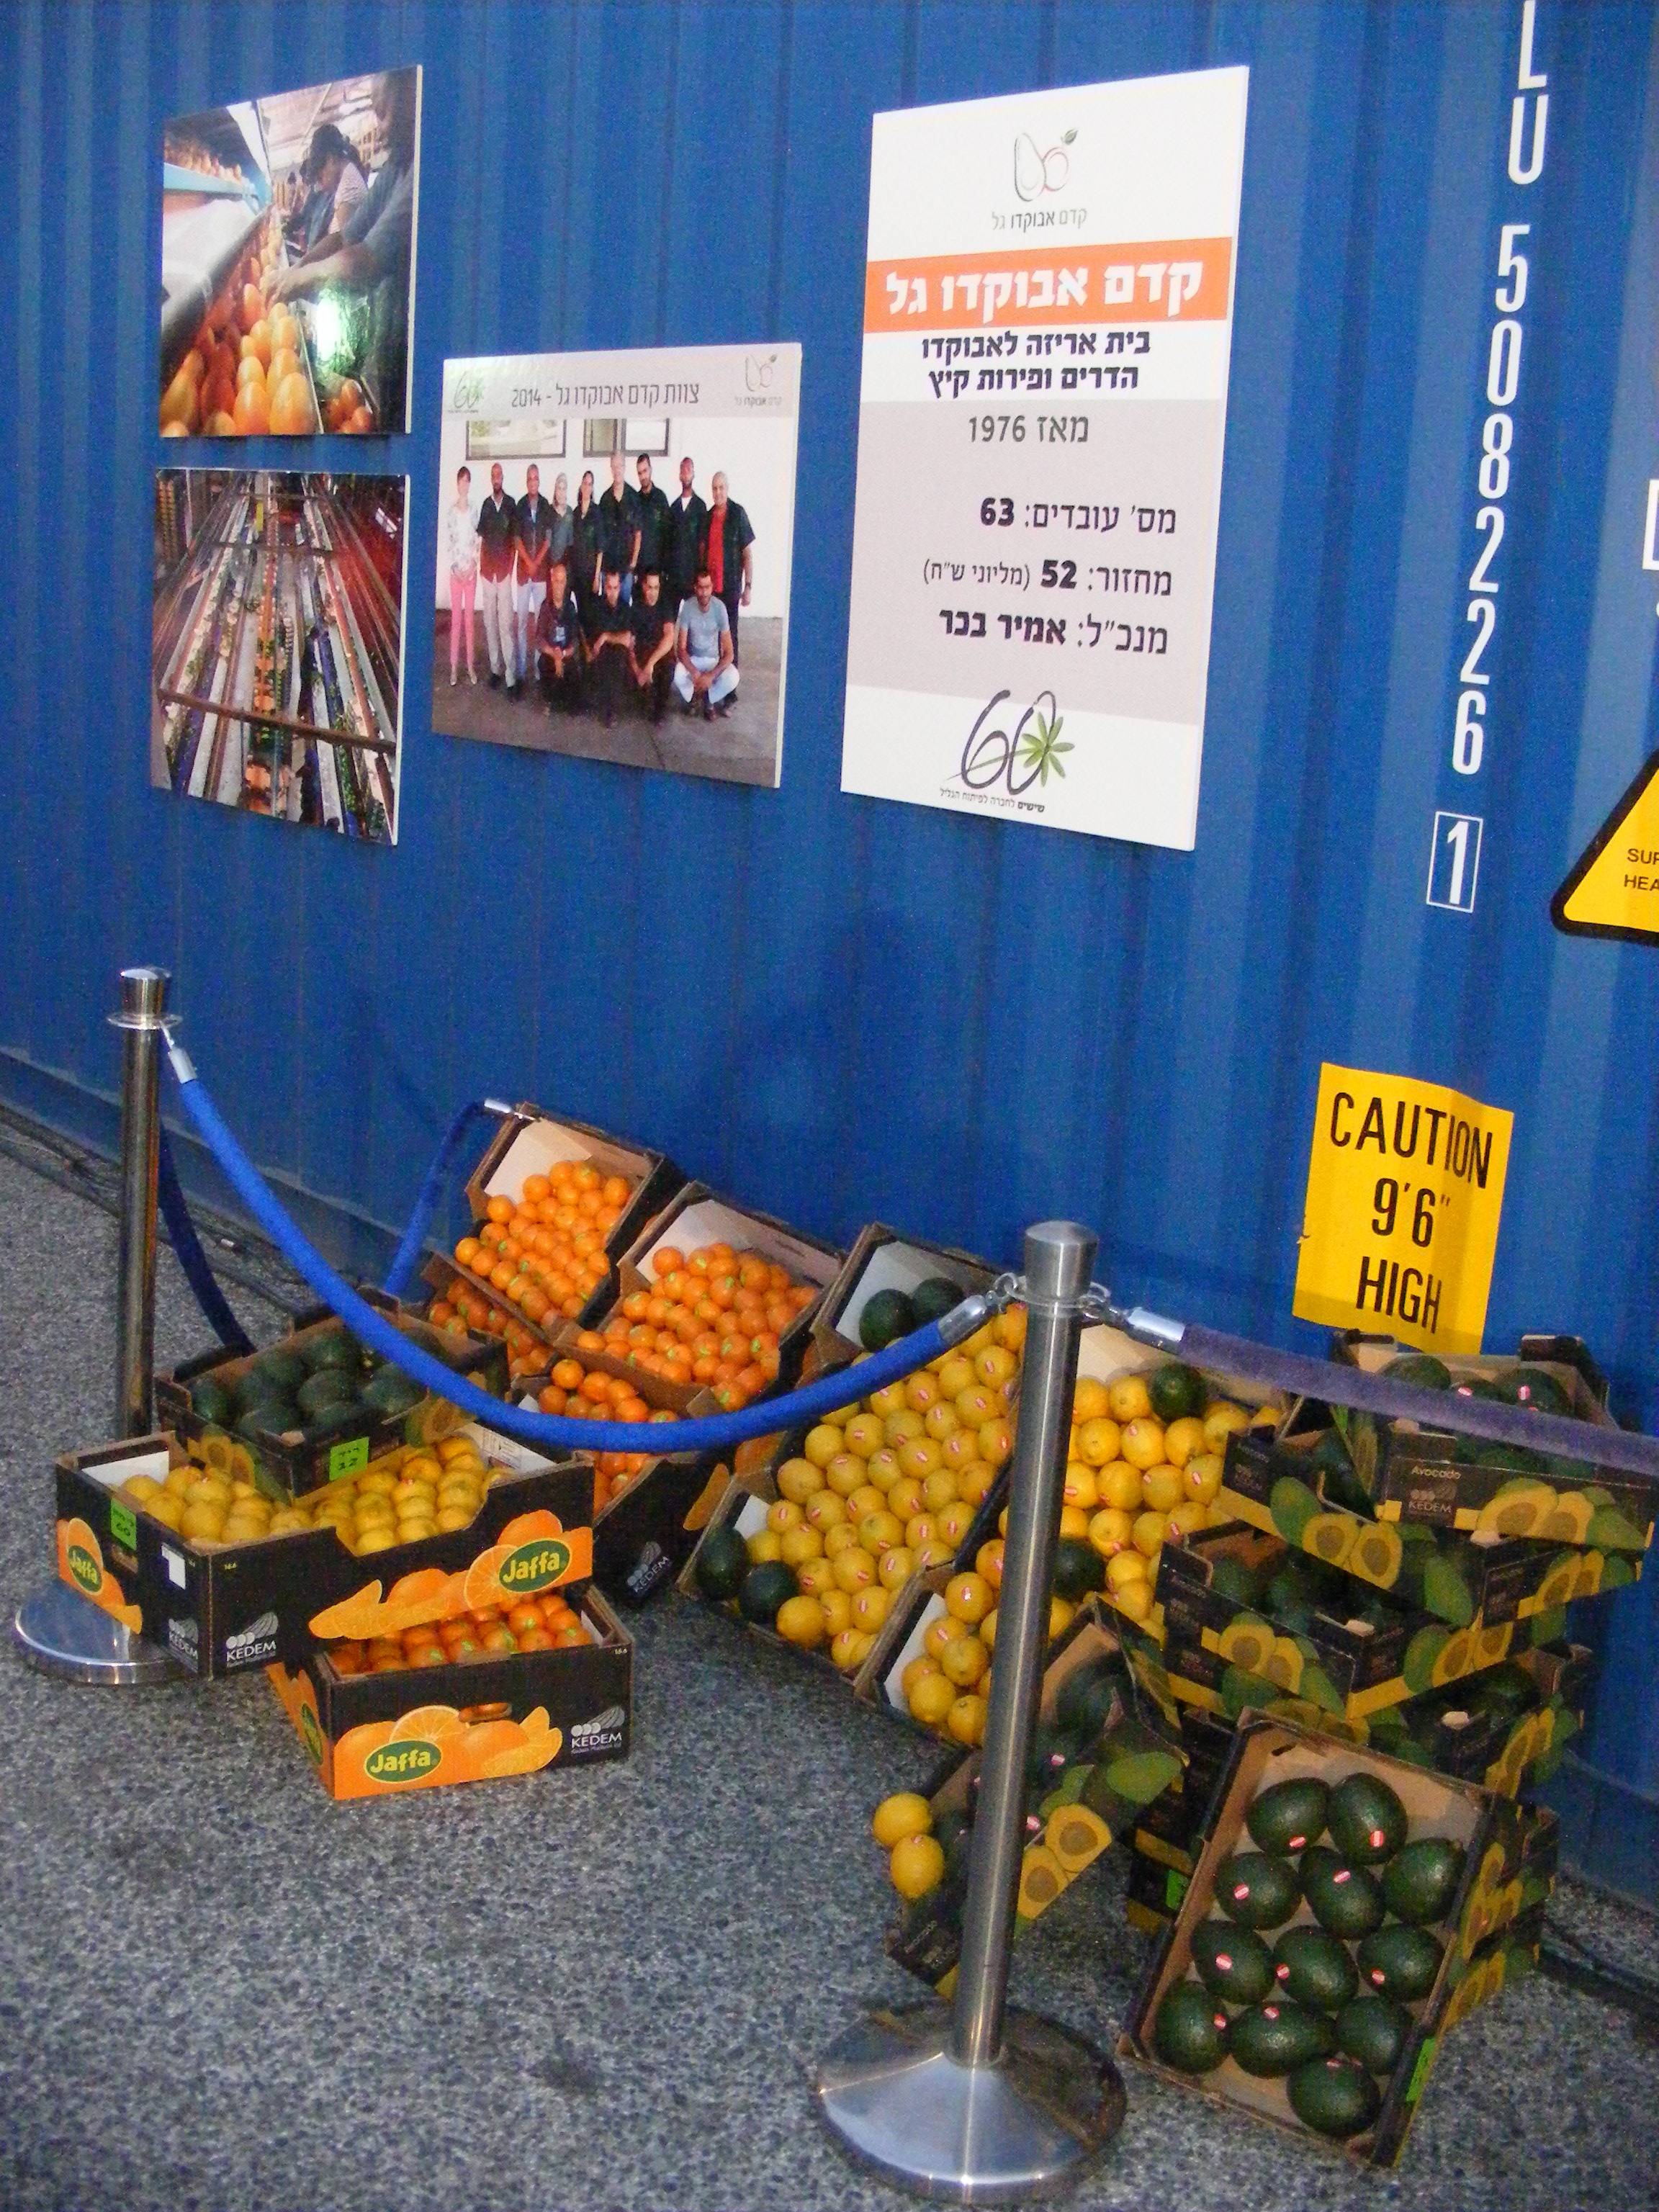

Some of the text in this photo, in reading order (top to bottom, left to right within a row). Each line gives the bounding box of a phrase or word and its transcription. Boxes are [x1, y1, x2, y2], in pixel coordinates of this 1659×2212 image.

[992, 208, 1087, 233] קדם אבוקדו גל
[886, 260, 1204, 325] קדם אבוקדו גל
[922, 330, 1151, 365] בית אריזה לאבוקדו
[555, 382, 570, 406] גל
[575, 385, 624, 409] אבוקדו
[628, 384, 660, 409] קדם
[663, 383, 700, 405] צוות
[929, 366, 1138, 399] הדרים ופירות קיץ
[511, 388, 541, 408] 2014
[968, 415, 1089, 443] מאז 1976
[980, 496, 1015, 527] 63
[1024, 503, 1120, 534] עובדים:
[1040, 559, 1078, 590] 52
[1088, 566, 1172, 596] מחזור:
[938, 609, 987, 638] בכר
[997, 613, 1066, 646] אמיר
[961, 690, 1057, 796] 60
[1017, 801, 1046, 813] שישים
[1448, 821, 1469, 905] 1
[1330, 1092, 1493, 1189] CAUTION
[1356, 1256, 1442, 1334] HIGH
[1411, 1465, 1461, 1480] Avocado
[503, 1551, 560, 1583] Jaffa
[634, 1556, 668, 1593] KEDEM
[226, 1640, 277, 1662] KEDEM
[571, 1732, 623, 1749] KEDEM
[370, 1749, 431, 1773] Jaffa
